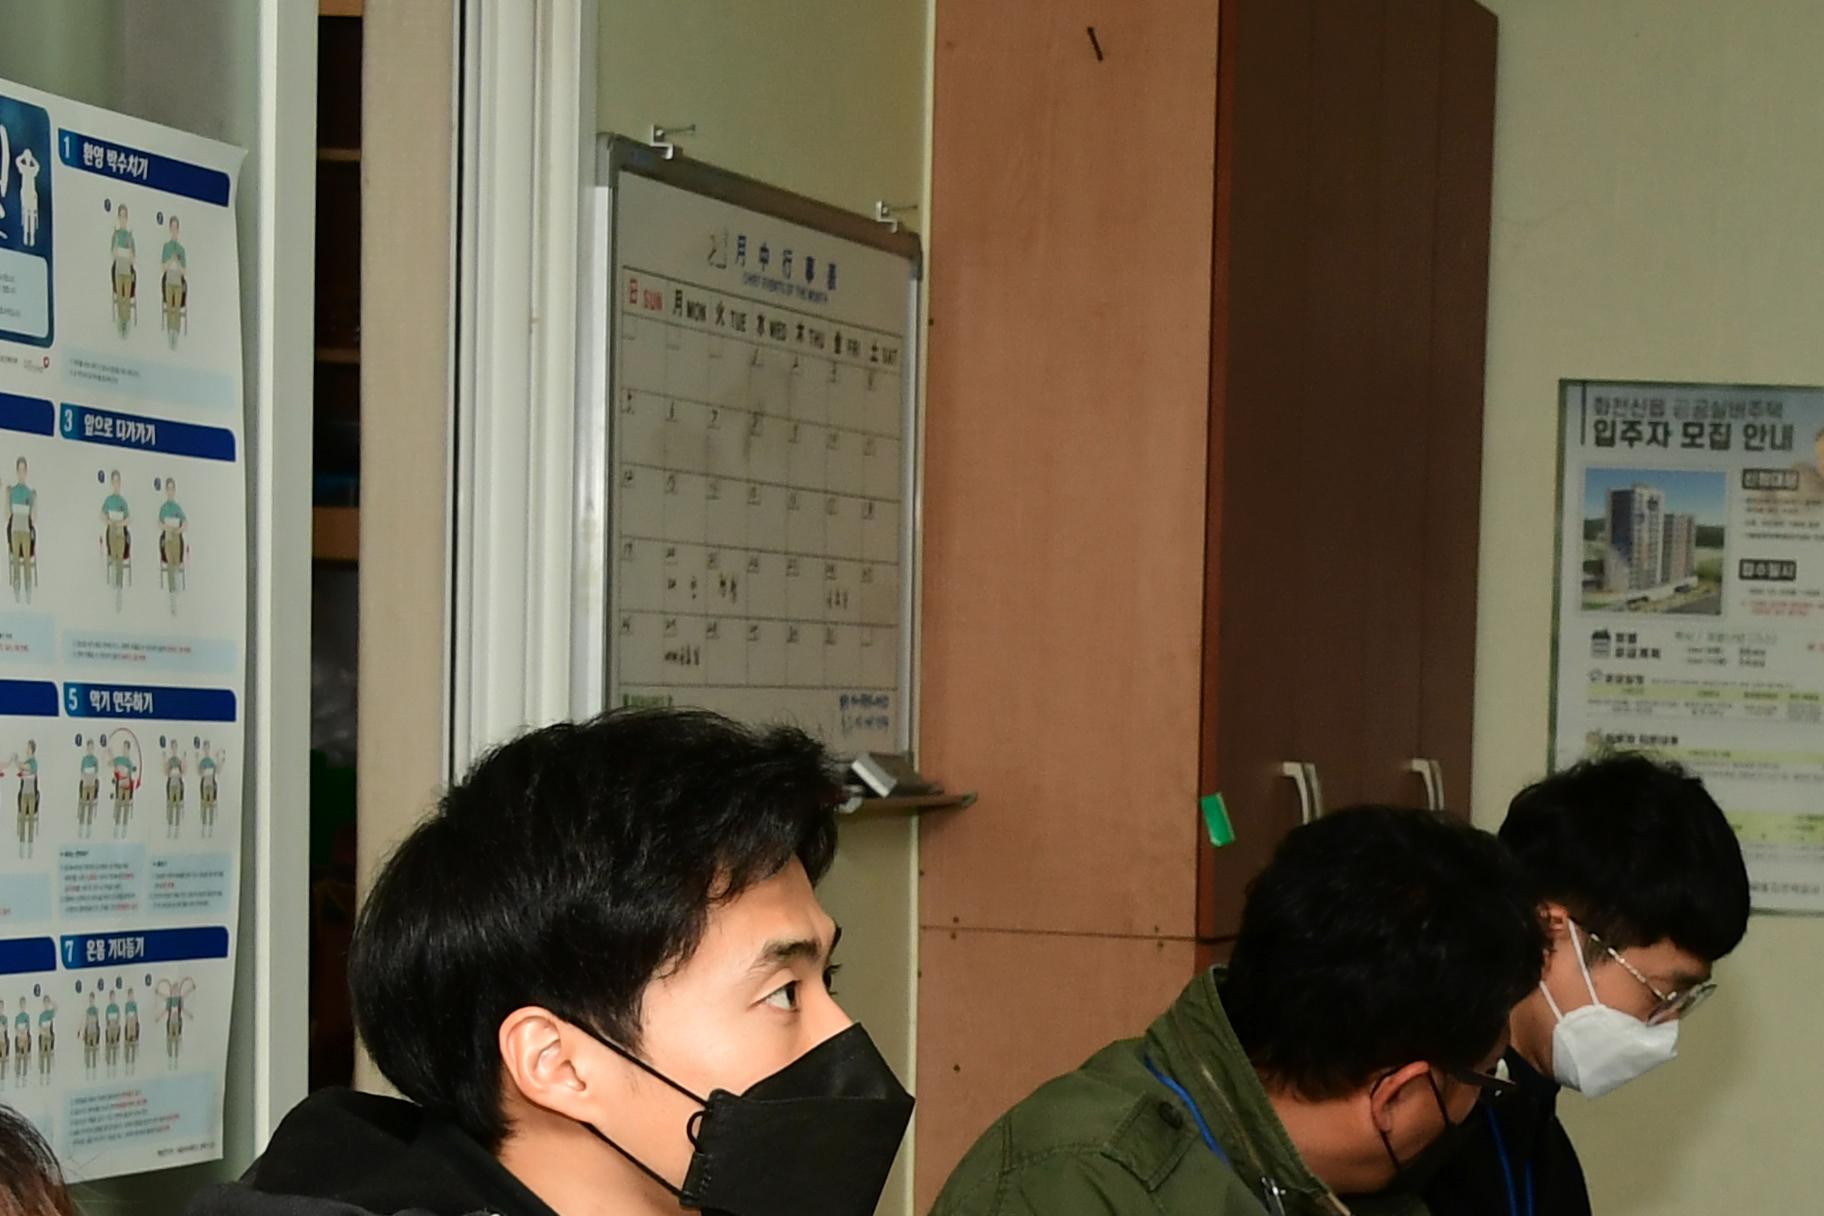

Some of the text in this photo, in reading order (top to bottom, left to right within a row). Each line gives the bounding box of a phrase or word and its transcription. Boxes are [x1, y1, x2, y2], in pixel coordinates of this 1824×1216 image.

[63, 136, 149, 180] 1 환영 박수치기
[643, 290, 663, 311] SUN
[687, 300, 707, 322] MON
[730, 310, 746, 332] TUE
[769, 320, 787, 341] WED
[64, 409, 156, 446] 3 앞으로 다가가기
[1593, 420, 1793, 451] 입주자 모집 안내
[68, 688, 154, 714] 5 악기 연주하기
[65, 936, 145, 962] 7 온몸 가다듬기
